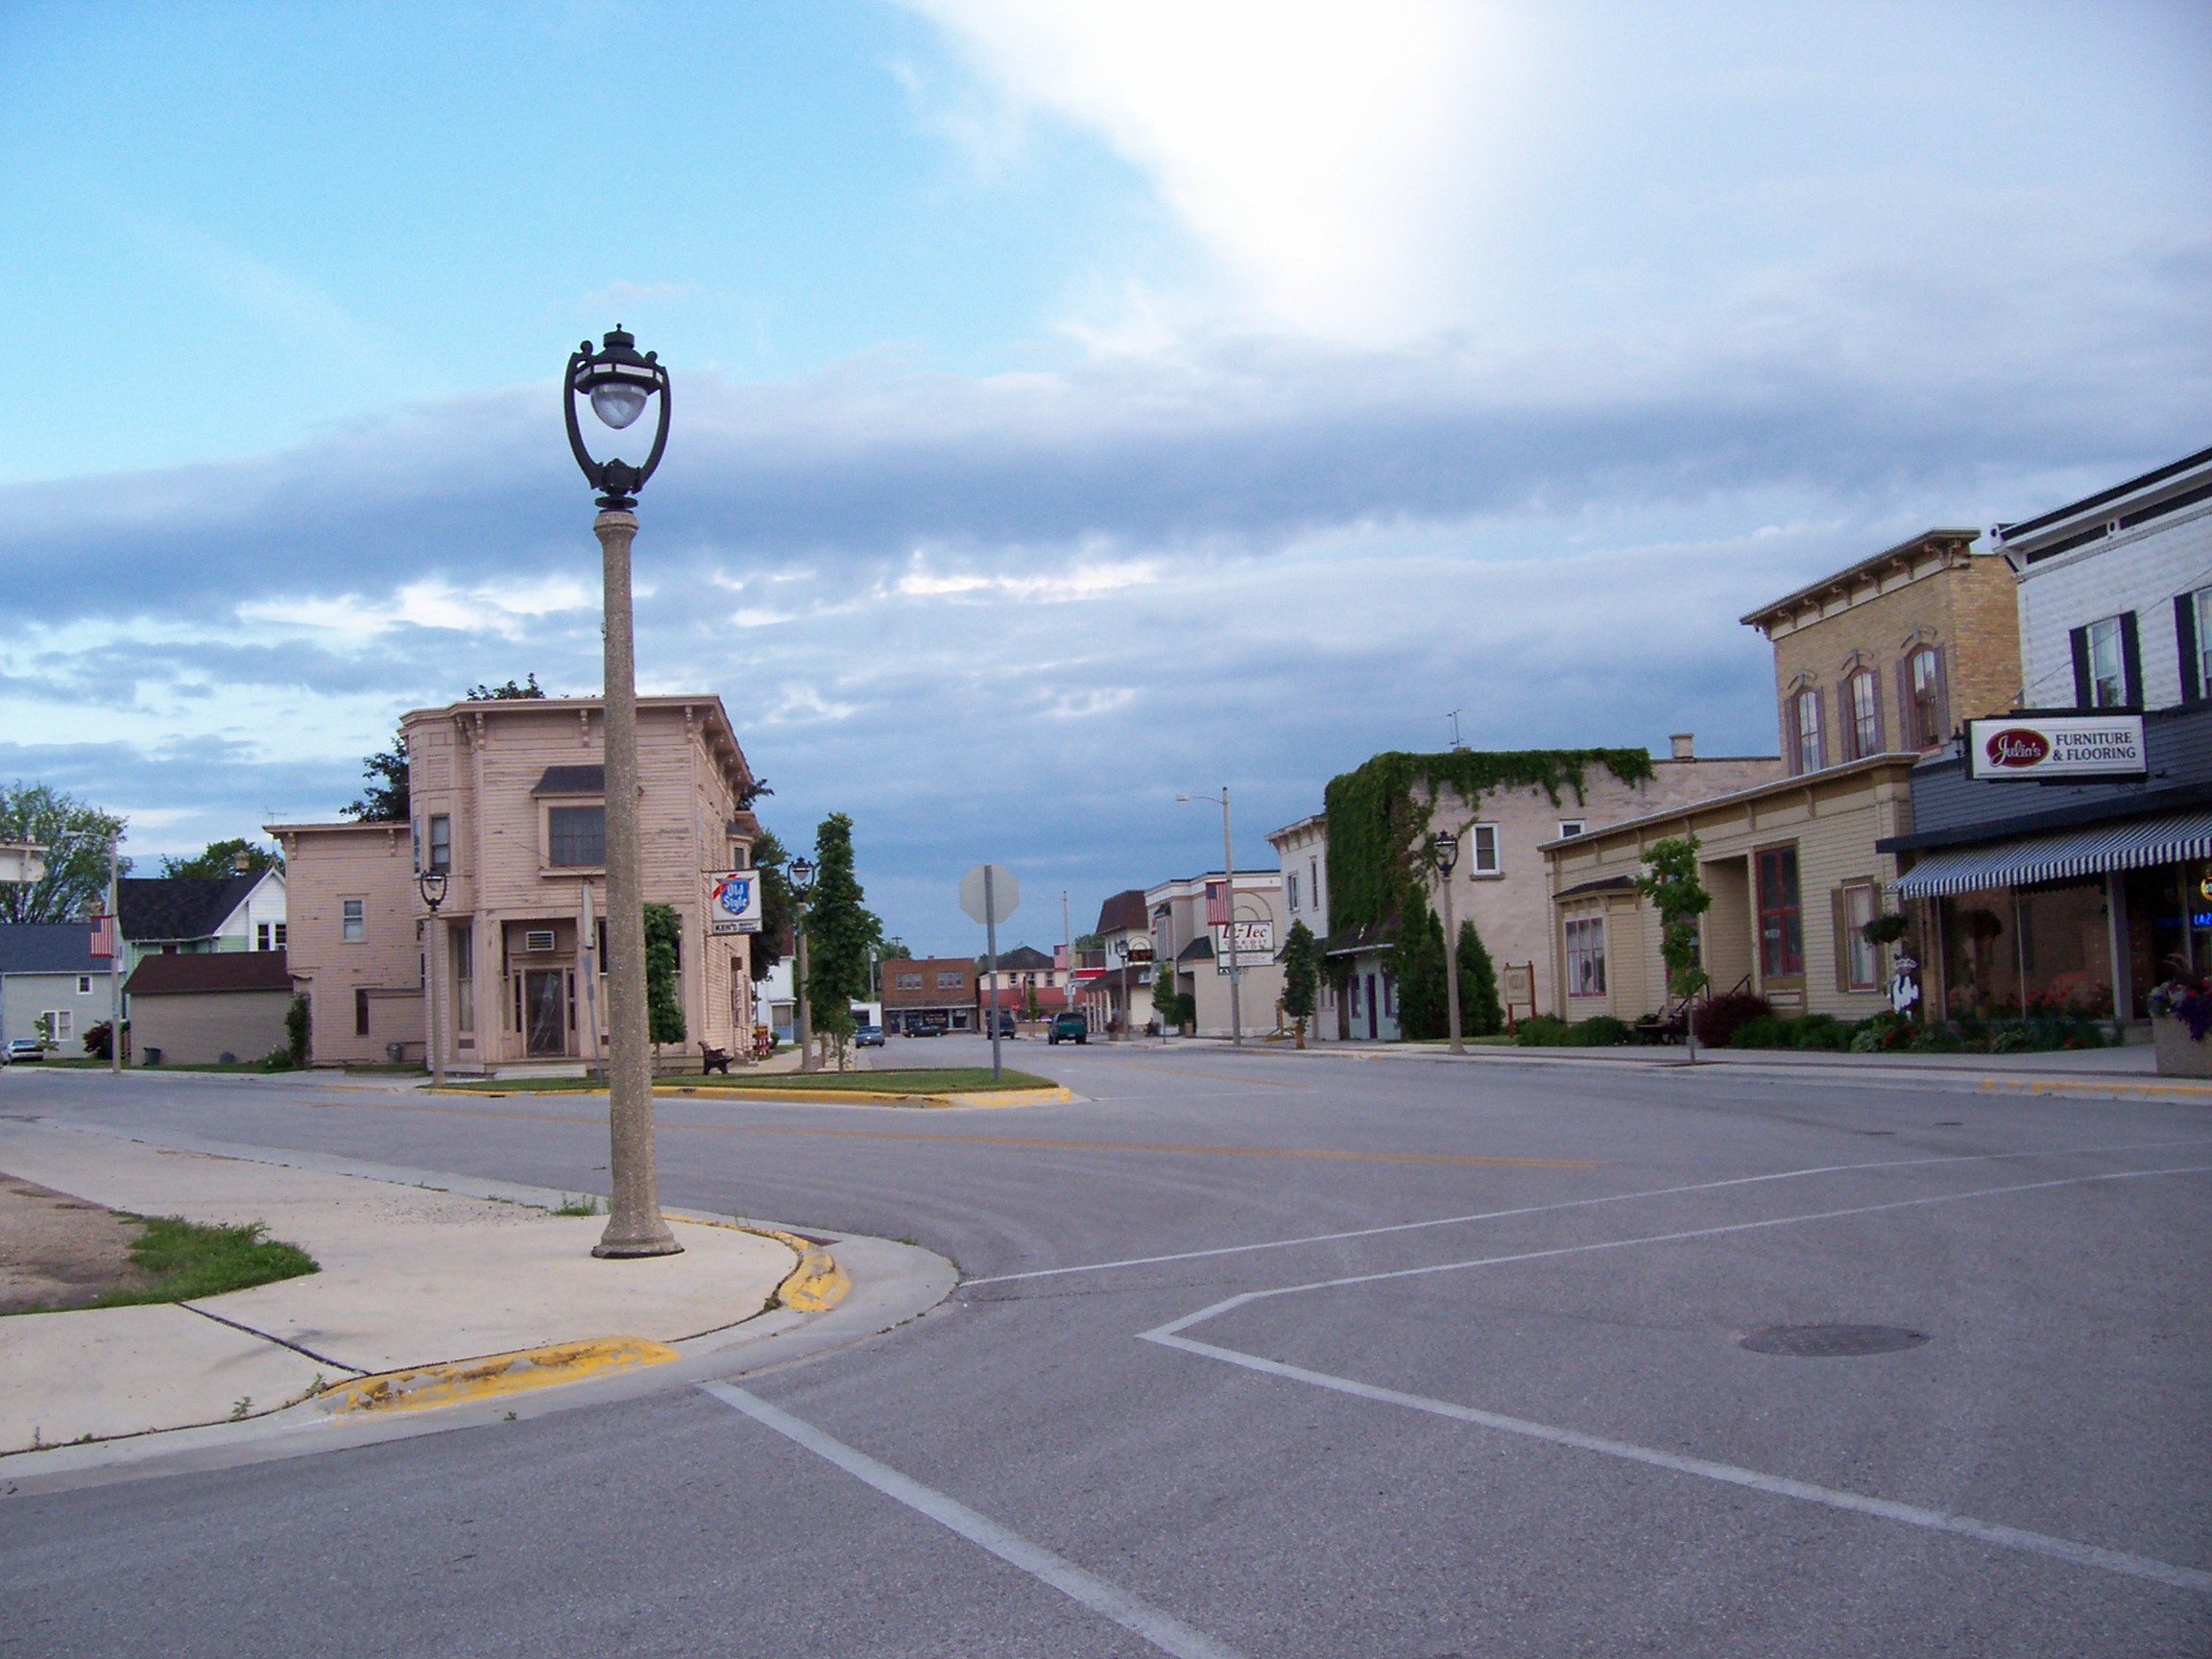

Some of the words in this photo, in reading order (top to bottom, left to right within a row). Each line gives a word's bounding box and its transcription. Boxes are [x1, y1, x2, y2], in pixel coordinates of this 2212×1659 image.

[2056, 733, 2132, 746] FURNITURE
[1990, 735, 2041, 767] Julia's
[2052, 750, 2063, 761] &
[2067, 747, 2136, 760] FLOORING
[728, 883, 744, 897] Old
[723, 896, 747, 912] Style
